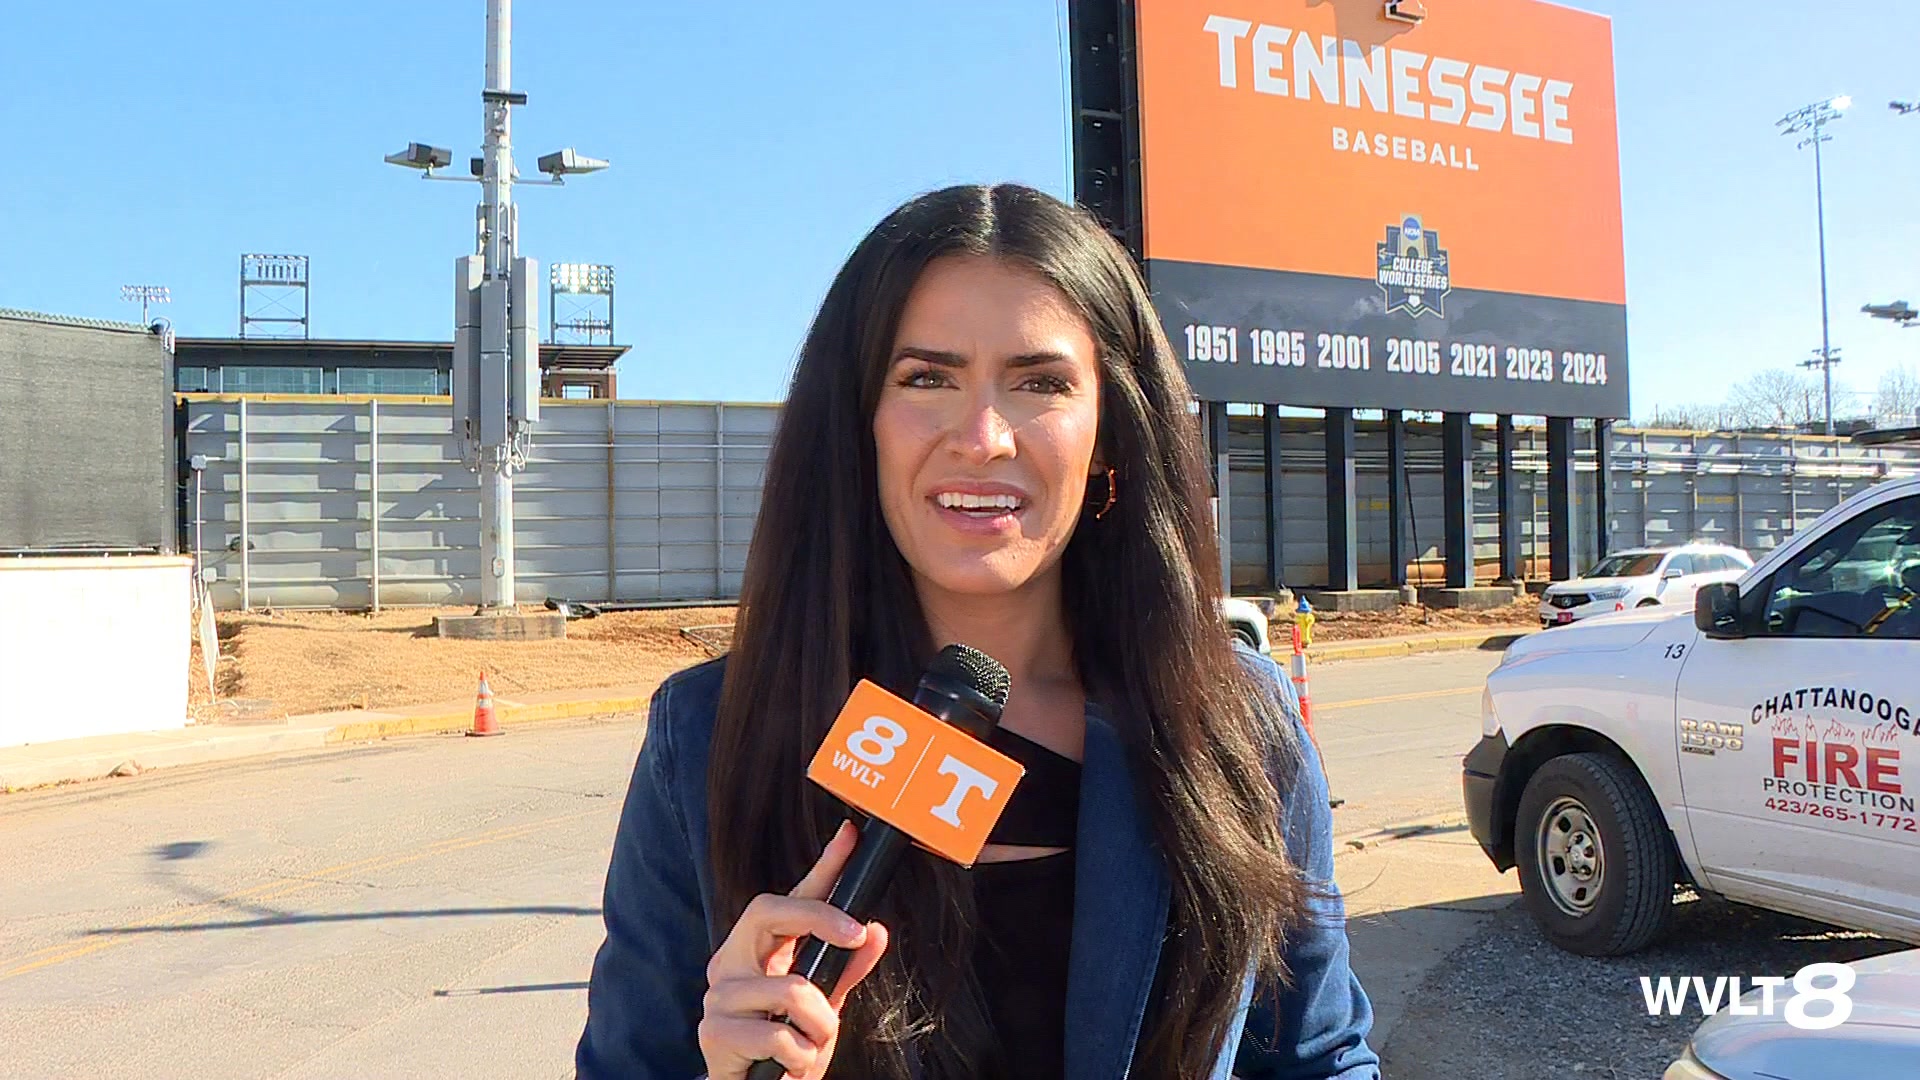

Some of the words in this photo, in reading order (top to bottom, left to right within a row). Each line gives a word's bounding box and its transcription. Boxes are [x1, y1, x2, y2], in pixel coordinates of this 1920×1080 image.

[1203, 15, 1574, 144] TENNESSEE
[1332, 127, 1479, 171] BASEBALL
[1379, 270, 1414, 287] WORLD
[1414, 273, 1448, 290] SERIES
[1392, 257, 1434, 274] COLLEGE
[1184, 324, 1238, 363] 1951
[1250, 328, 1305, 367] 1995
[1317, 333, 1370, 370] 2001
[1386, 338, 1440, 375] 2005
[1450, 343, 1496, 378] 2021
[1505, 347, 1553, 382] 2023
[1562, 352, 1608, 386] 2024
[1663, 644, 1685, 659] 13
[846, 715, 908, 766] 8
[1680, 718, 1744, 737] RAM
[1681, 731, 1744, 751] 1500
[832, 750, 886, 789] WVLT
[1772, 737, 1902, 795] FIRE
[929, 754, 999, 828] T
[1763, 778, 1915, 813] PROTECTION
[1765, 798, 1918, 833] 423/265-1772
